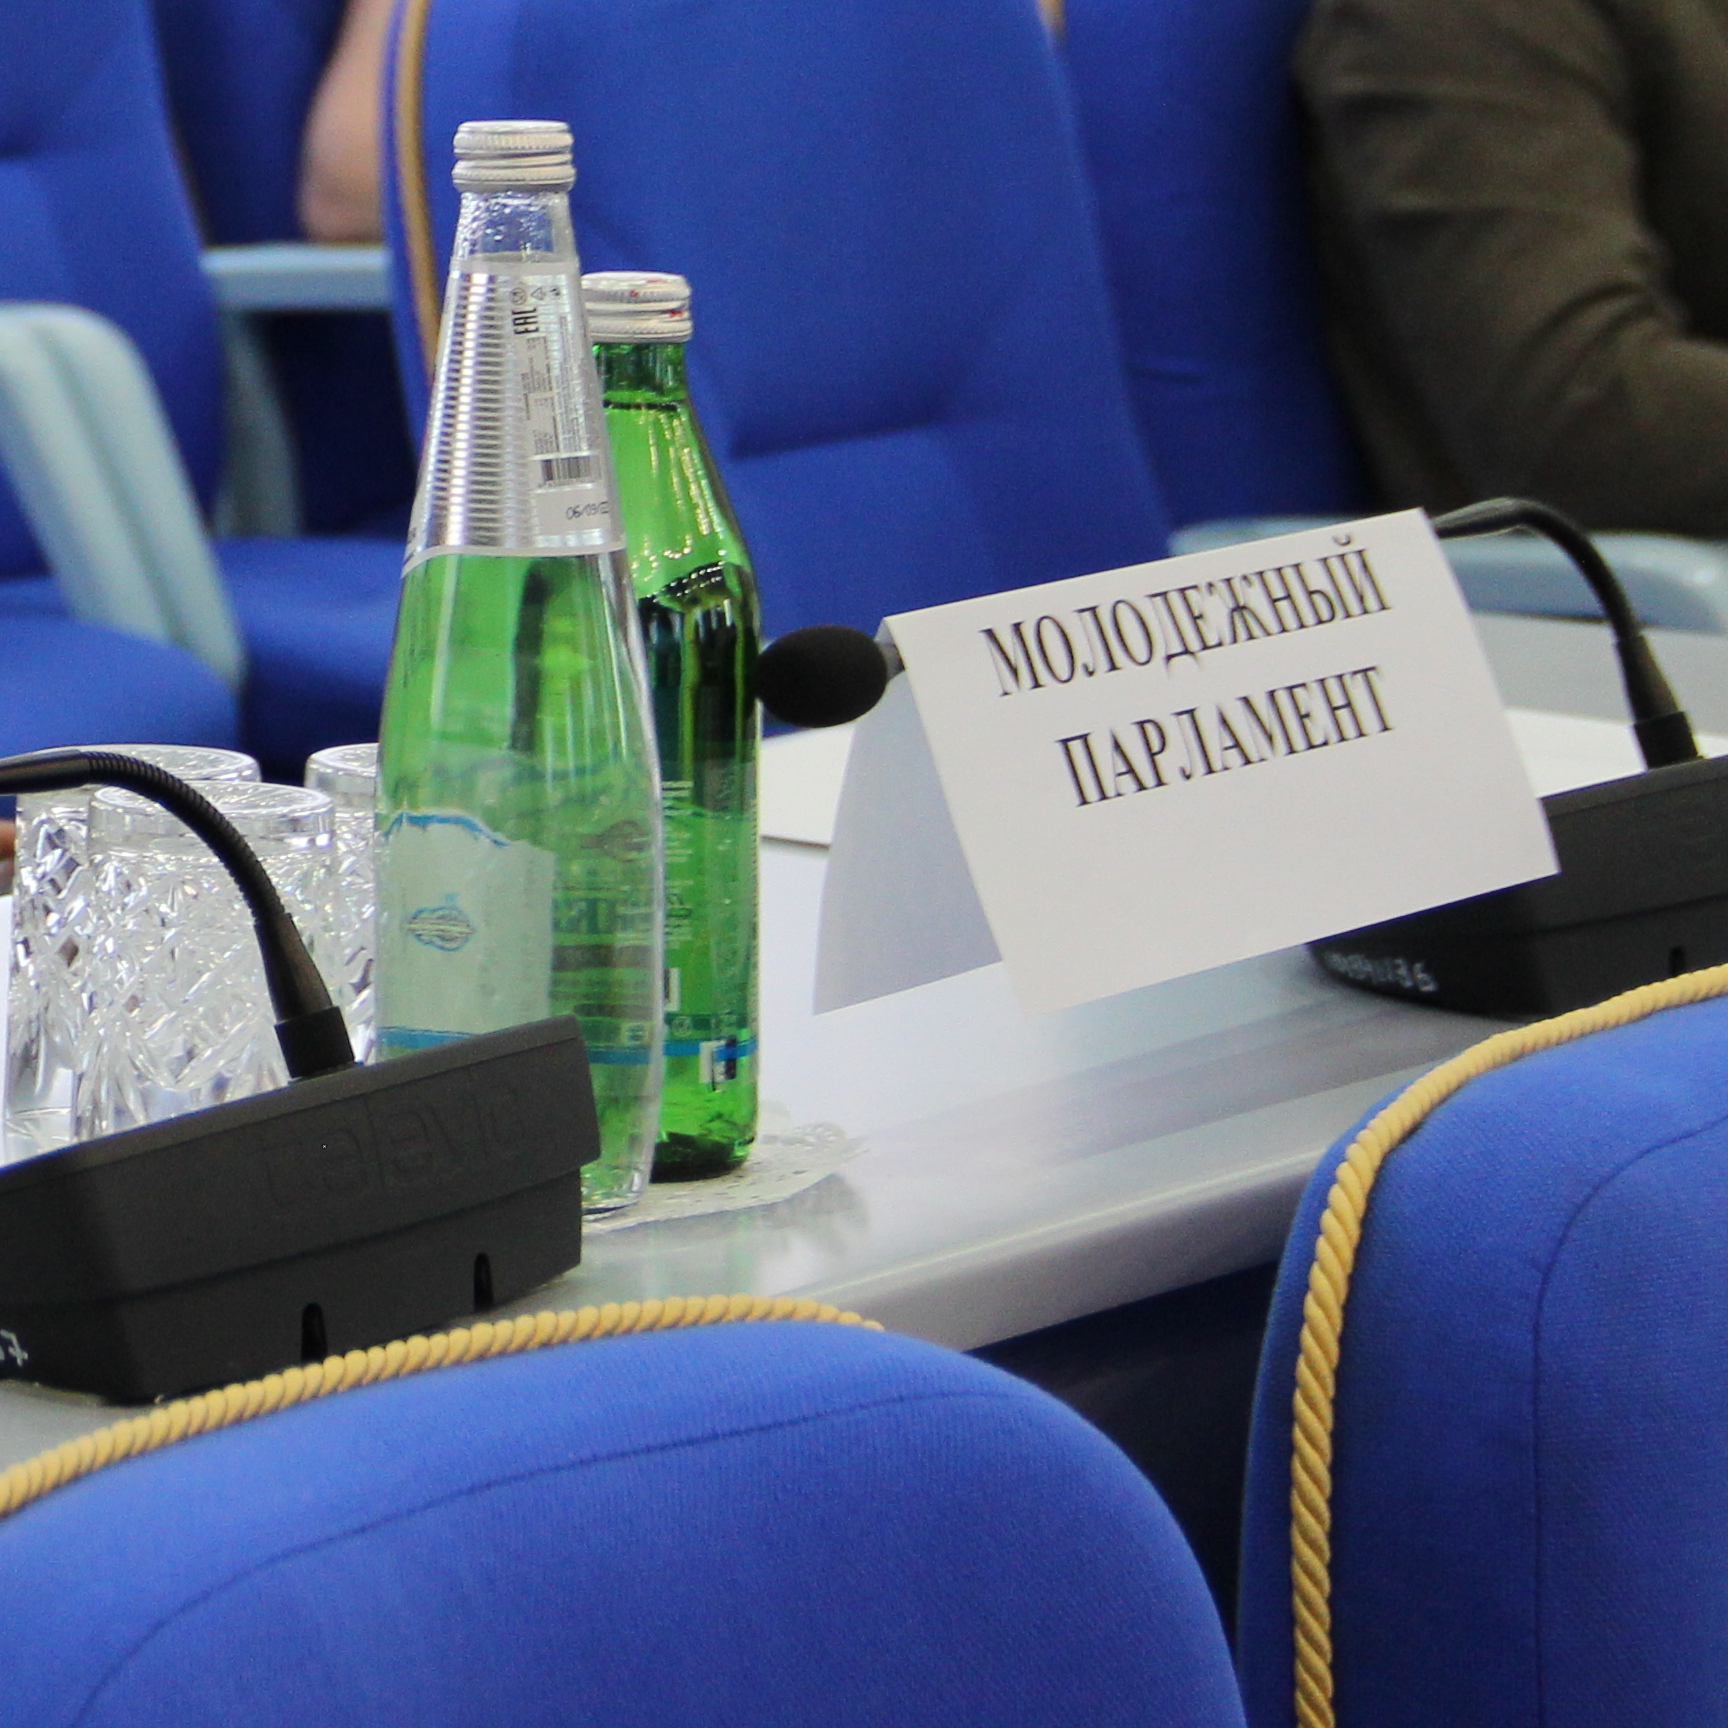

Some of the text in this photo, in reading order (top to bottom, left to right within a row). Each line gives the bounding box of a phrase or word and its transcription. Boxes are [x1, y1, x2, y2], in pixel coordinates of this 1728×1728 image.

[511, 308, 539, 335] EAC
[978, 533, 1392, 697] МОЛОДЕЖНЫЙ
[1055, 666, 1394, 807] ПАРЛАМЕНТ
